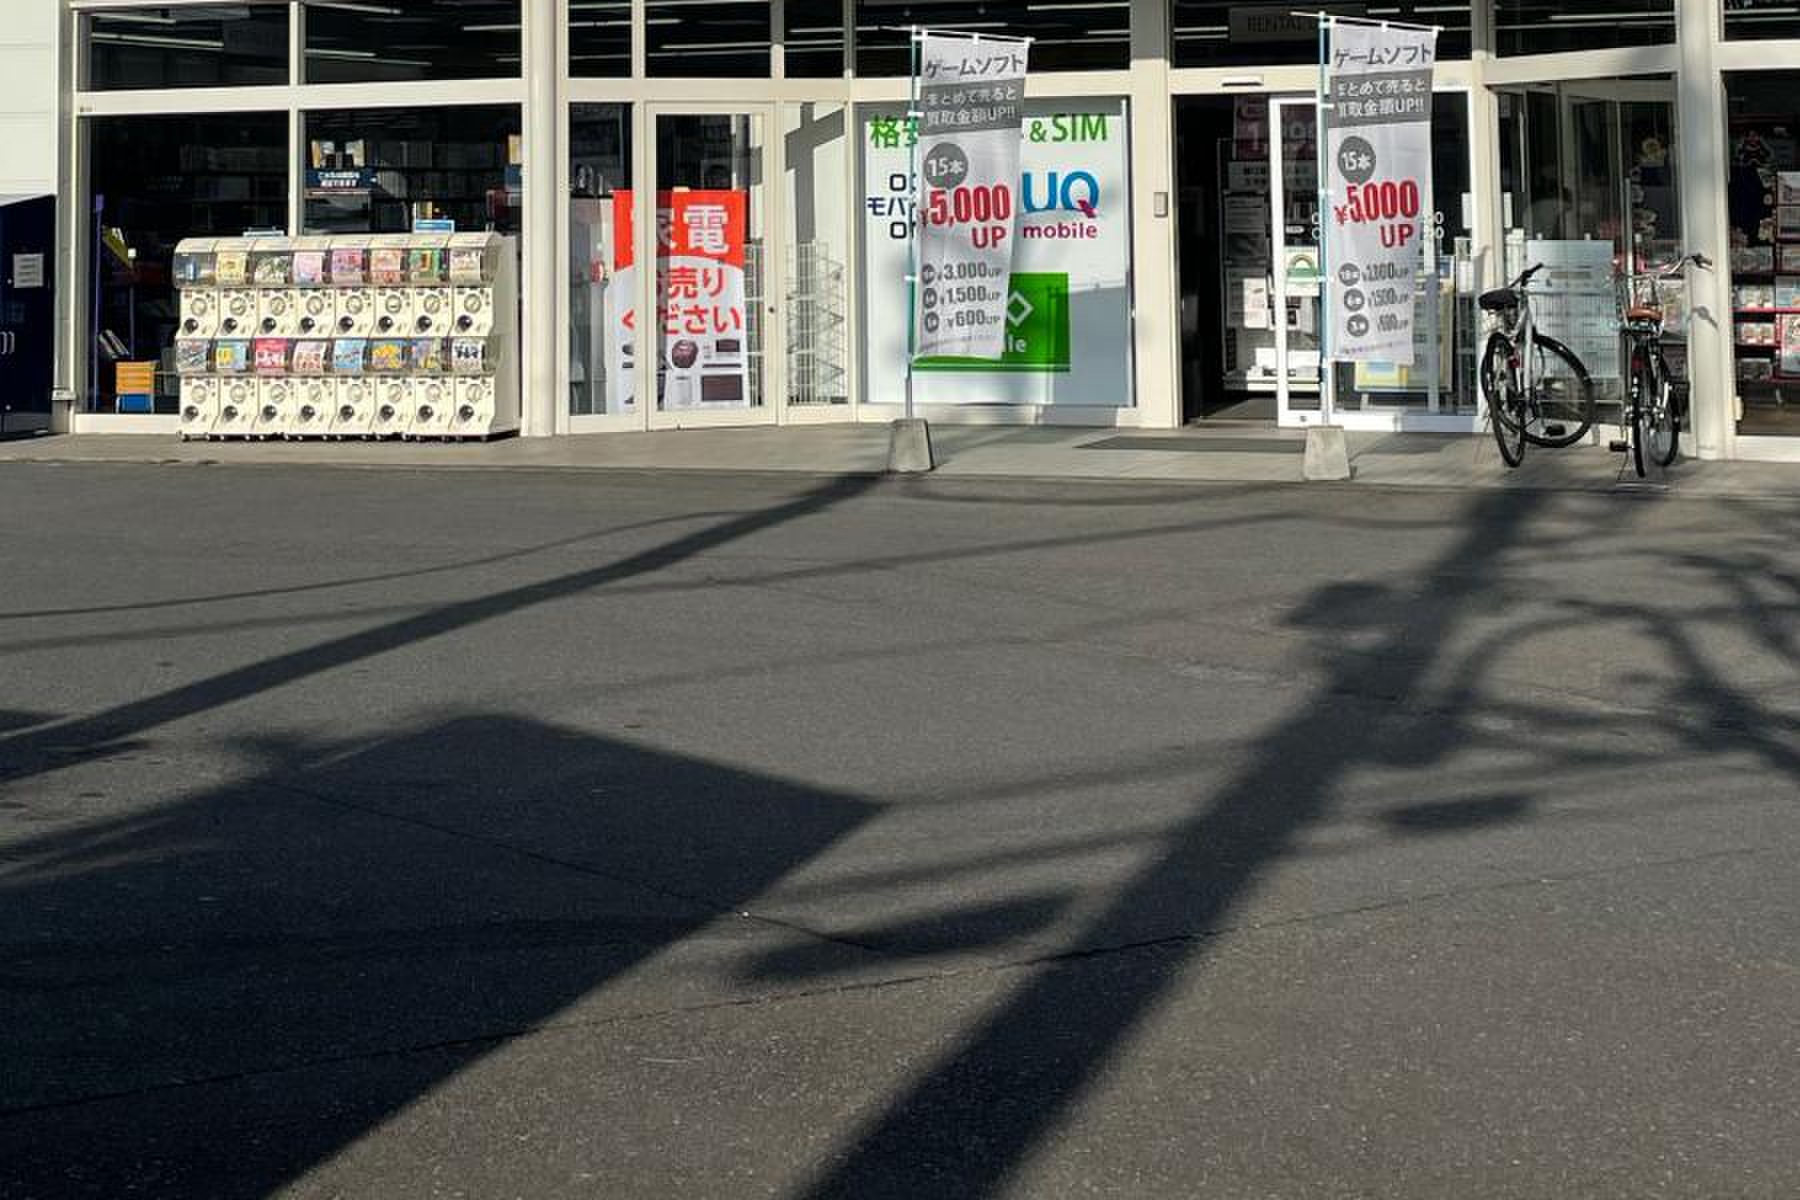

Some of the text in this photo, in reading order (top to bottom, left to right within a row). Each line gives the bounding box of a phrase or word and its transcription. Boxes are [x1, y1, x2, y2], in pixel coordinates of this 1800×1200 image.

[924, 53, 1024, 79] ゲームソフト
[1333, 43, 1432, 68] ゲームソフト
[1022, 170, 1100, 218] UQ
[972, 226, 1007, 249] UP
[1022, 221, 1098, 240] mobile
[1380, 223, 1414, 248] UP
[656, 266, 724, 299] 売り
